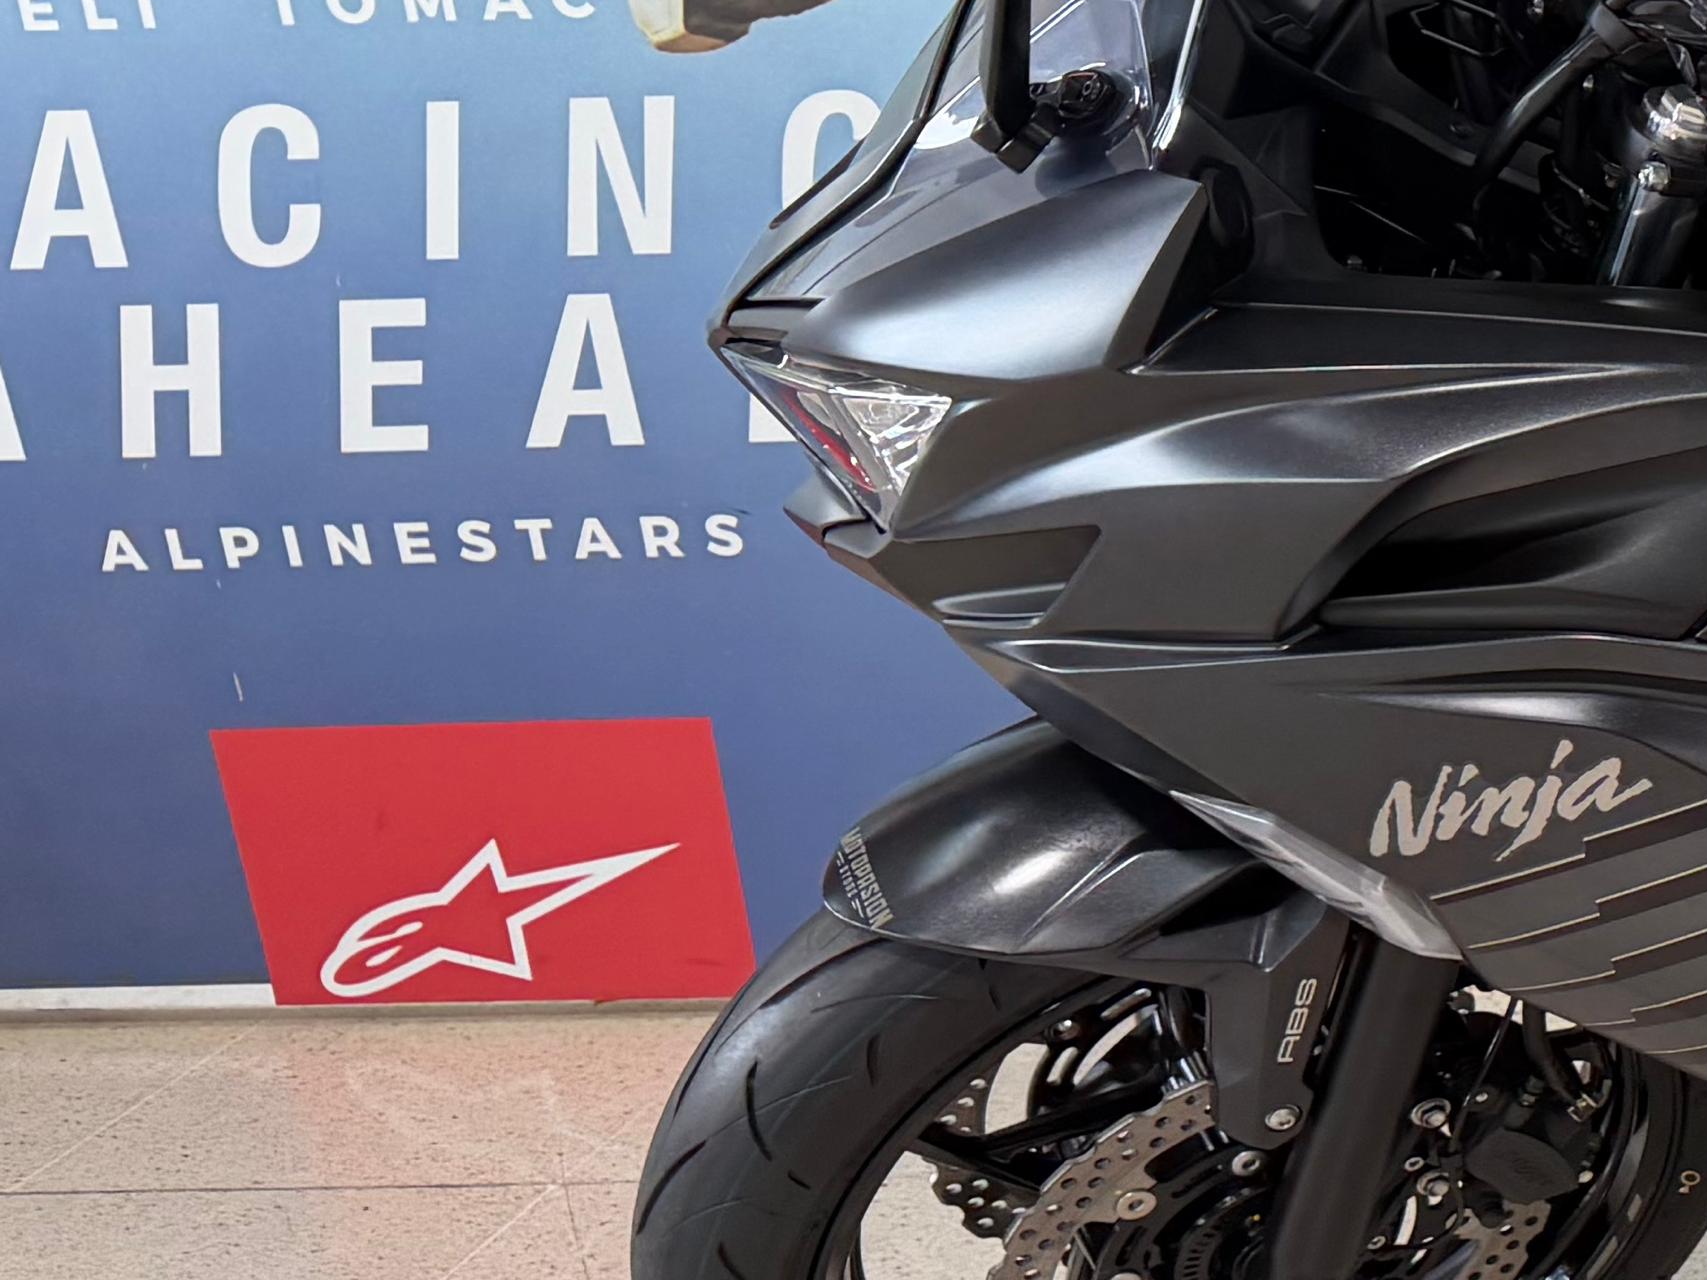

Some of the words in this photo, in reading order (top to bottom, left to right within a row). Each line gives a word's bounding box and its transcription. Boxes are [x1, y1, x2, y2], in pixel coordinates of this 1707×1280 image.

[0, 292, 798, 462] HEA
[101, 514, 745, 572] ALPINESTARS
[1369, 740, 1653, 861] Ninja
[1277, 978, 1318, 1063] ABS
